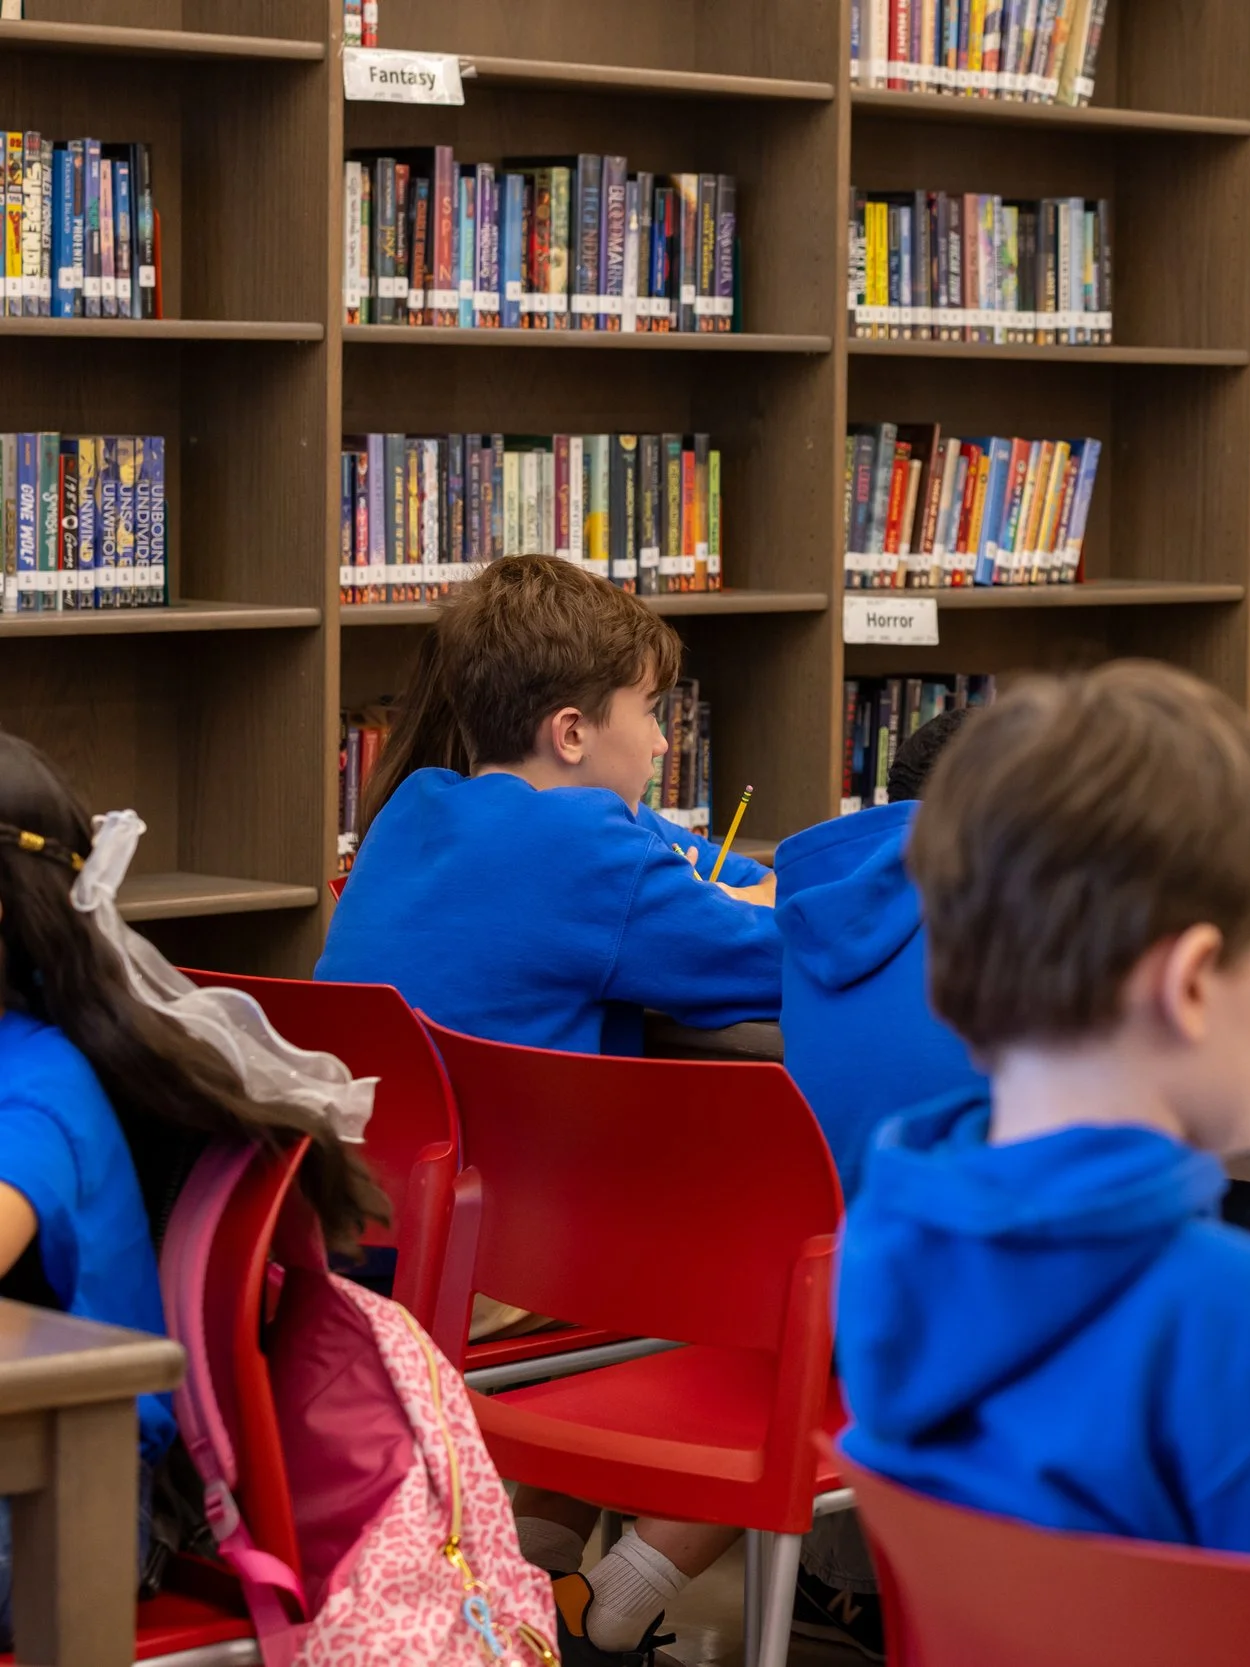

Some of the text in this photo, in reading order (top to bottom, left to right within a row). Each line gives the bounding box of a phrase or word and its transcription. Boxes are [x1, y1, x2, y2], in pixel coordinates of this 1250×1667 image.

[369, 66, 436, 91] Fantasy
[22, 162, 42, 277] SUSPENDE
[606, 185, 625, 296] BLOODMARKE
[20, 484, 34, 567] GONE WOLF
[65, 475, 77, 514] 1984
[80, 486, 94, 562] UNWIND
[103, 483, 116, 567] UNWHOL
[119, 484, 133, 567] UNSOULE
[137, 483, 150, 567] UNDIVIDE
[151, 484, 164, 565] UNBOUN
[867, 612, 914, 628] Horror
